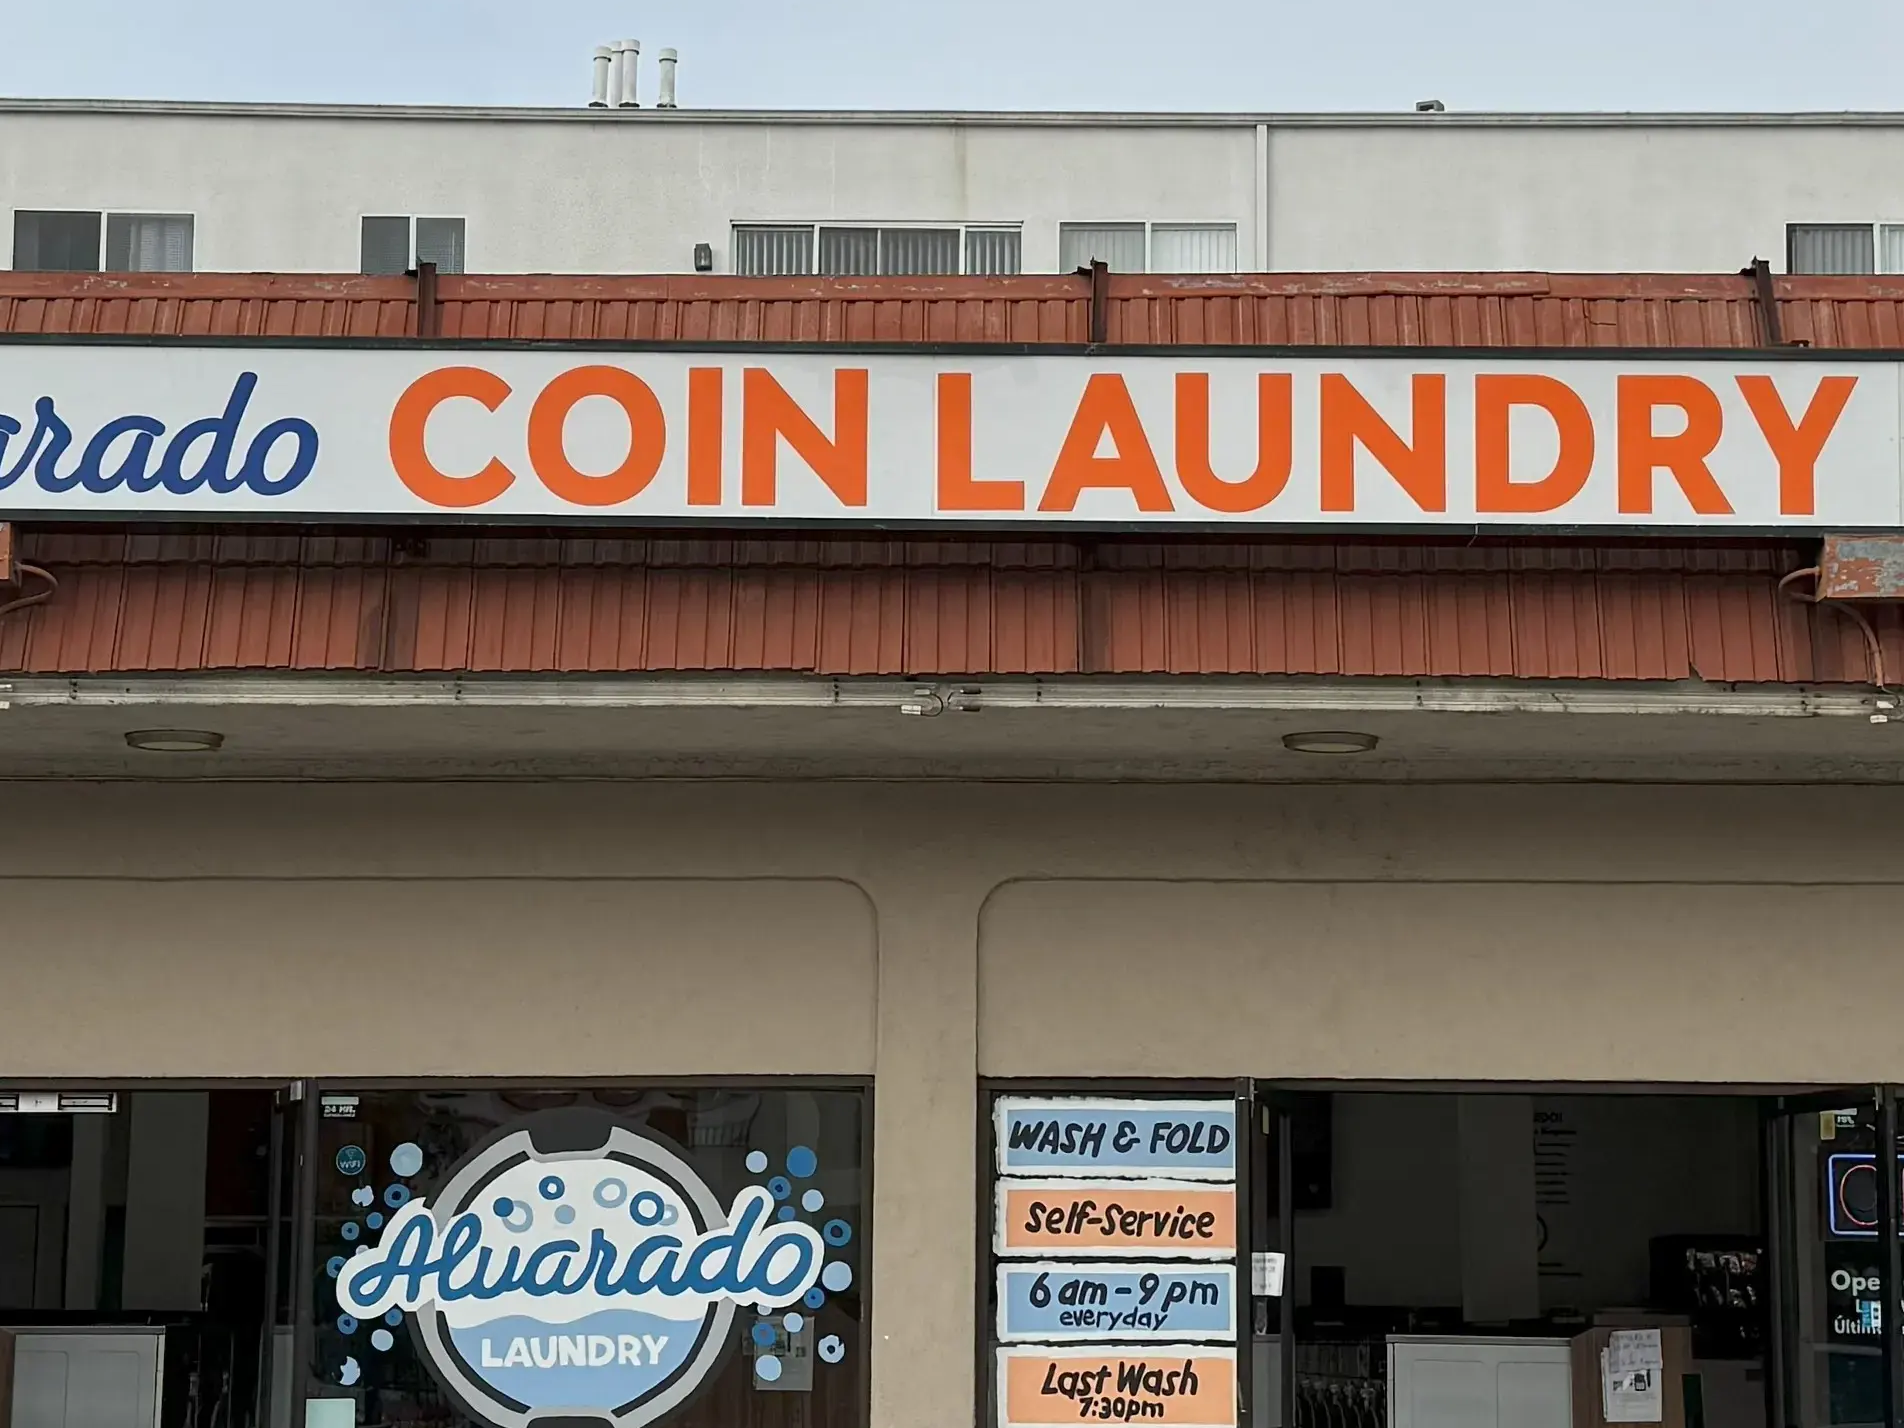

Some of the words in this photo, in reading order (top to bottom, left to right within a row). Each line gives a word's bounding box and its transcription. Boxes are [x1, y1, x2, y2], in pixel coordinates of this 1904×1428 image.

[388, 365, 869, 508] COIN
[936, 371, 1860, 517] LAUNDRY
[1008, 1120, 1107, 1158] WASH
[1112, 1120, 1141, 1154] &
[1149, 1121, 1231, 1154] FOLD
[1024, 1199, 1215, 1240] Self-Service
[348, 1194, 814, 1308] Alvarado
[1029, 1272, 1051, 1308] 6
[1057, 1279, 1108, 1306] am
[1138, 1273, 1160, 1305] 9
[1160, 1280, 1219, 1313] pm
[1830, 1269, 1881, 1297] Ope
[1059, 1306, 1168, 1331] everyday
[480, 1332, 669, 1369] LAUNDRY
[1040, 1362, 1113, 1400] Last
[1116, 1359, 1199, 1397] Wash
[1079, 1396, 1165, 1423] 7:30pm
